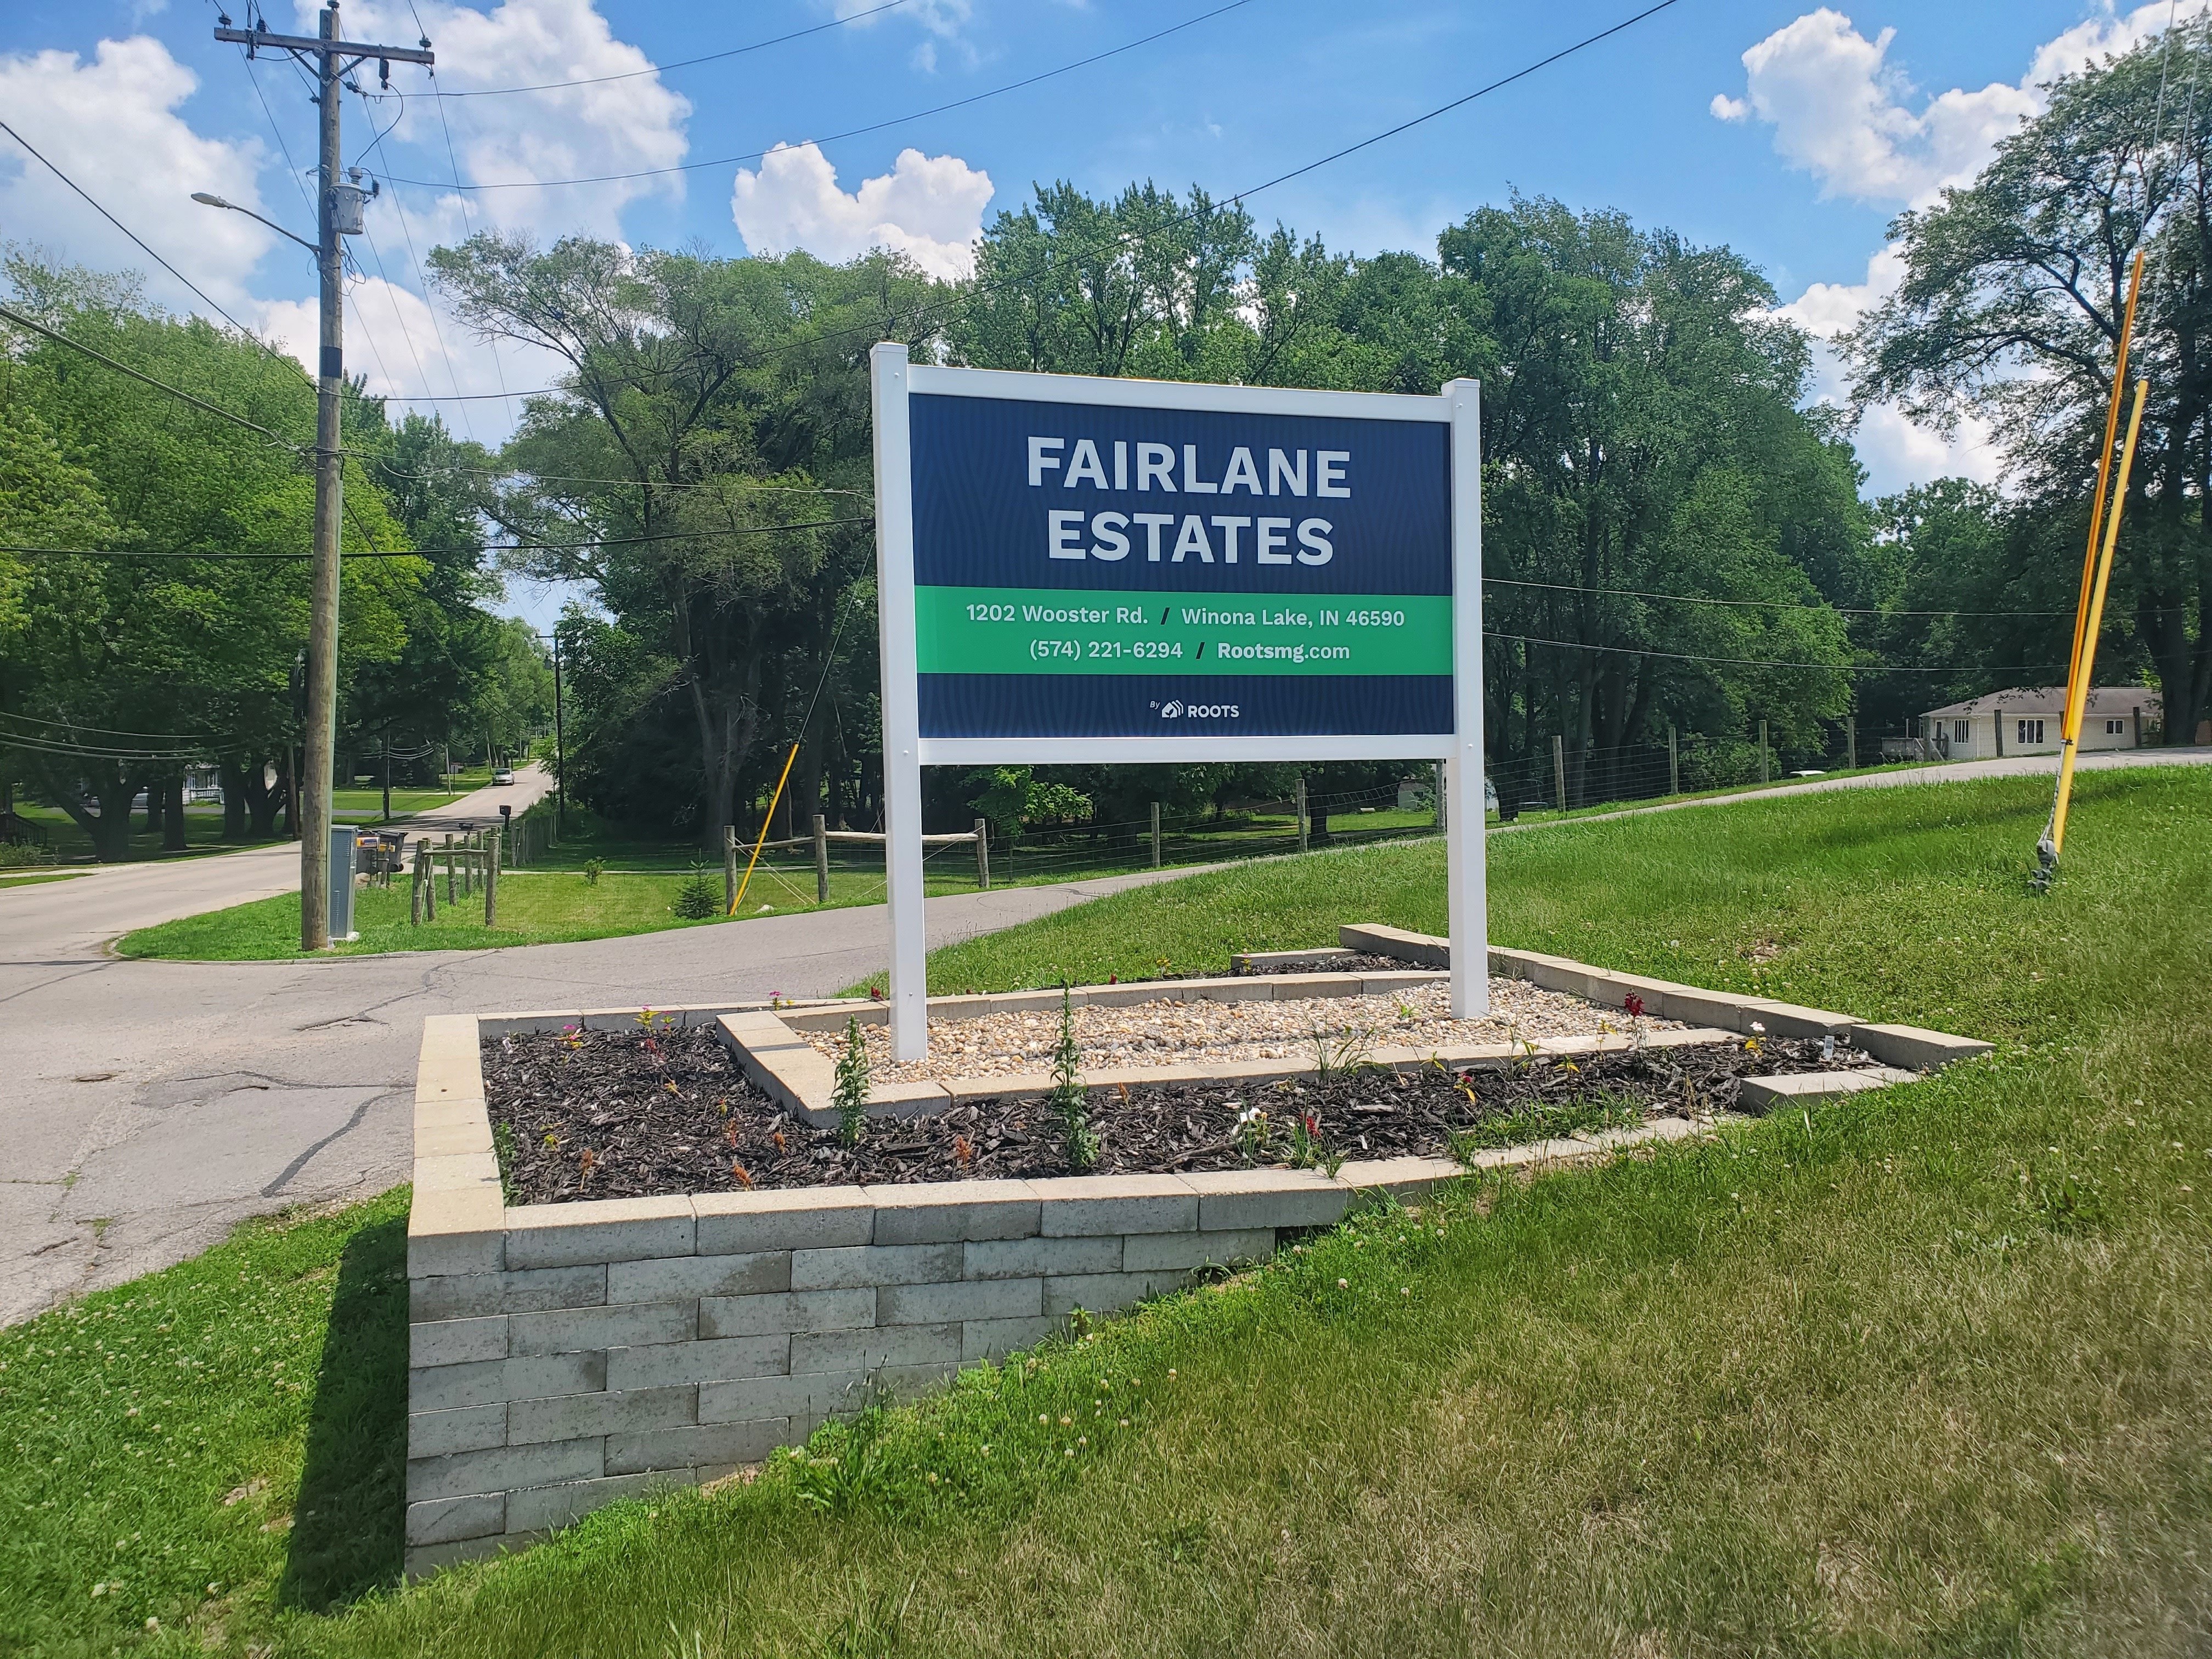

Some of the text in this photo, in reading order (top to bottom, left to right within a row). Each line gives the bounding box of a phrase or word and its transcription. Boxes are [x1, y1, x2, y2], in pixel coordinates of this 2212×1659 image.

[1028, 436, 1351, 498] FAIRLANE
[1048, 510, 1333, 566] ESTATES
[966, 604, 1015, 622] 1202
[1022, 605, 1110, 623] Wooster
[1116, 606, 1148, 624] Rd.
[1181, 607, 1256, 625] Winona
[1262, 608, 1313, 628] Lake,
[1319, 610, 1339, 627] IN
[1346, 610, 1404, 627] 46590
[1030, 639, 1081, 662] (574)
[1088, 641, 1183, 659] 221-6294
[1218, 642, 1350, 663] Rootsmg.com
[1149, 701, 1240, 718] By ROOTS
